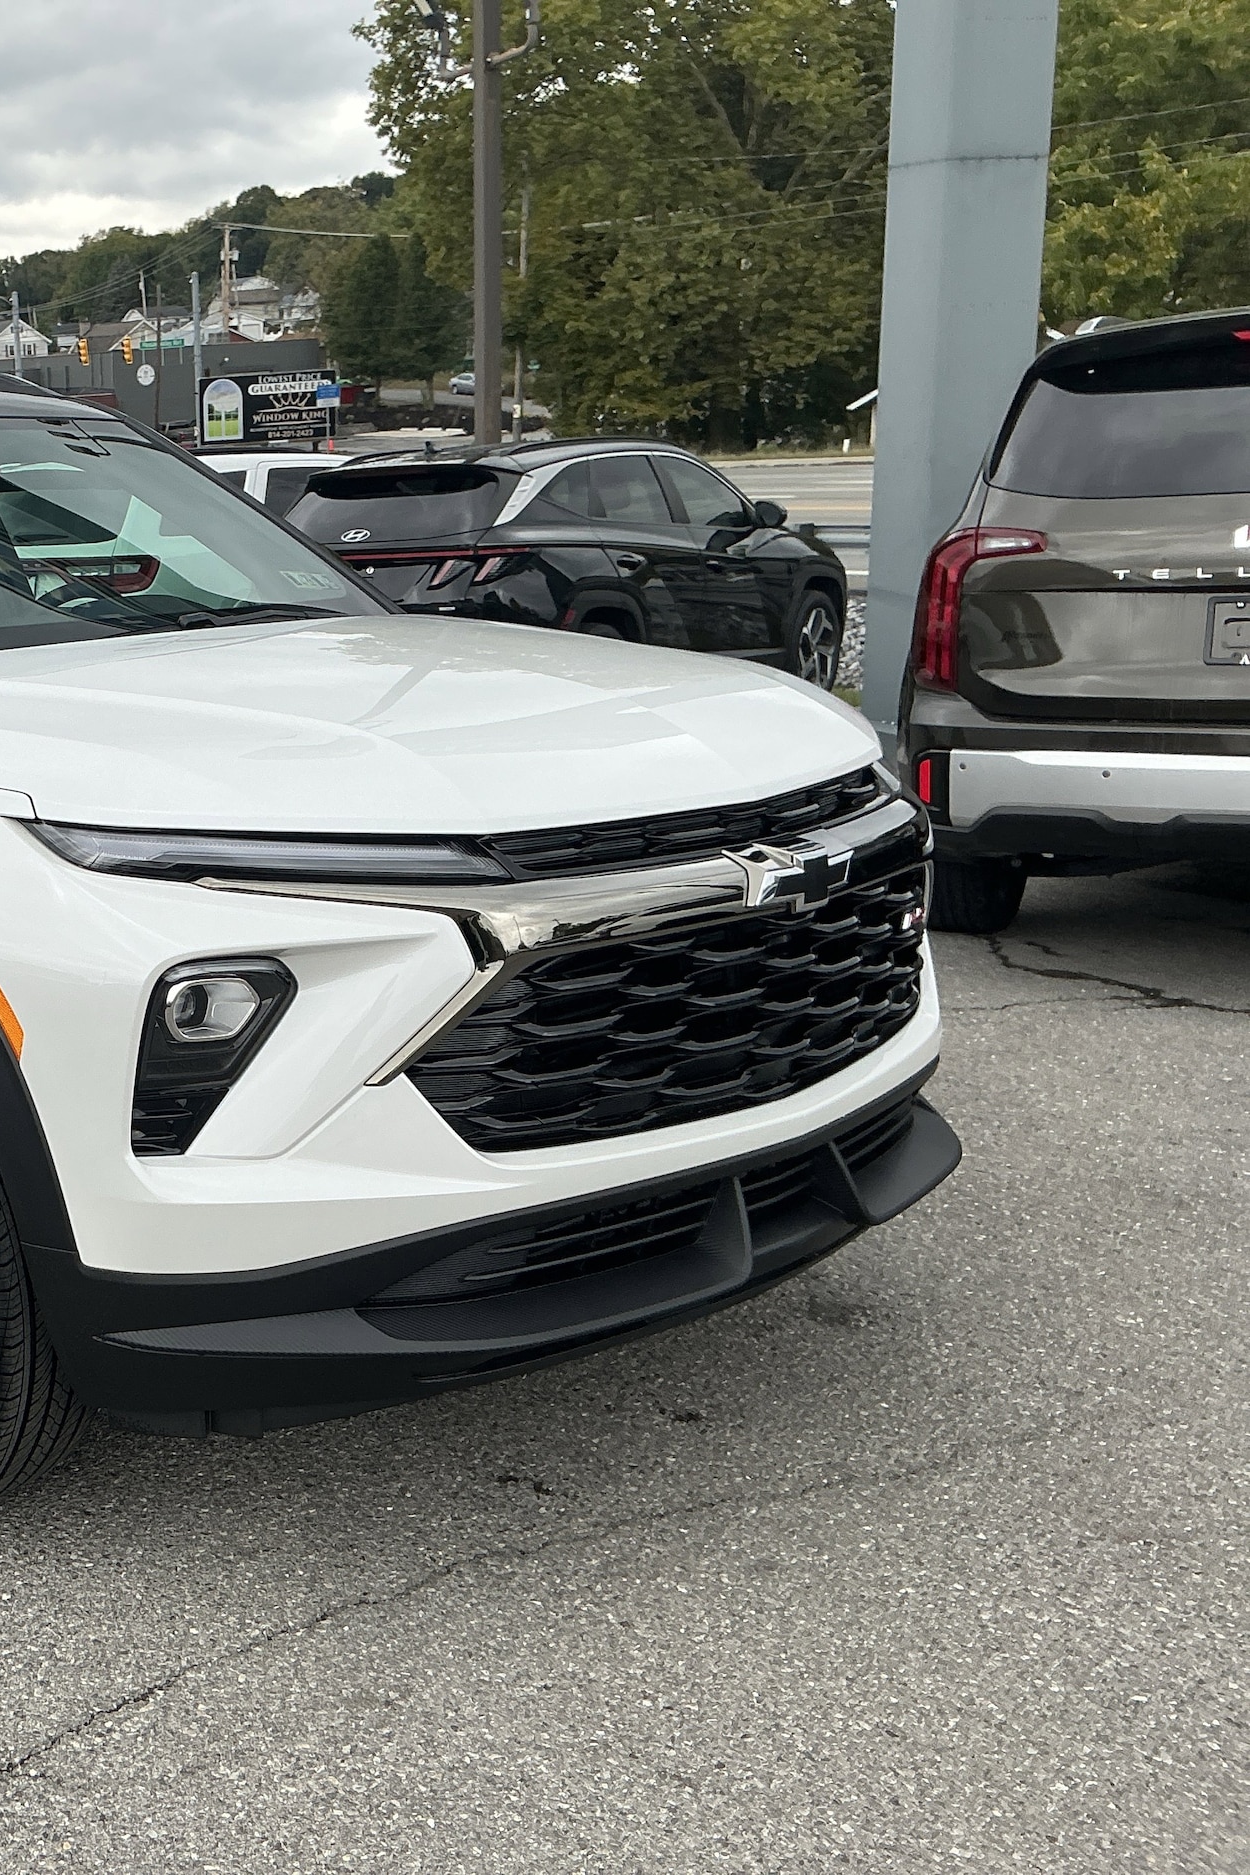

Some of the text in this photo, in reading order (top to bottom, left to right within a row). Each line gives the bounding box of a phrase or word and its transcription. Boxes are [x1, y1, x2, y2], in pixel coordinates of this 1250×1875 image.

[257, 372, 322, 384] LOWEST PRICE
[252, 410, 328, 424] WINDOW KING
[1112, 566, 1250, 581] TELL
